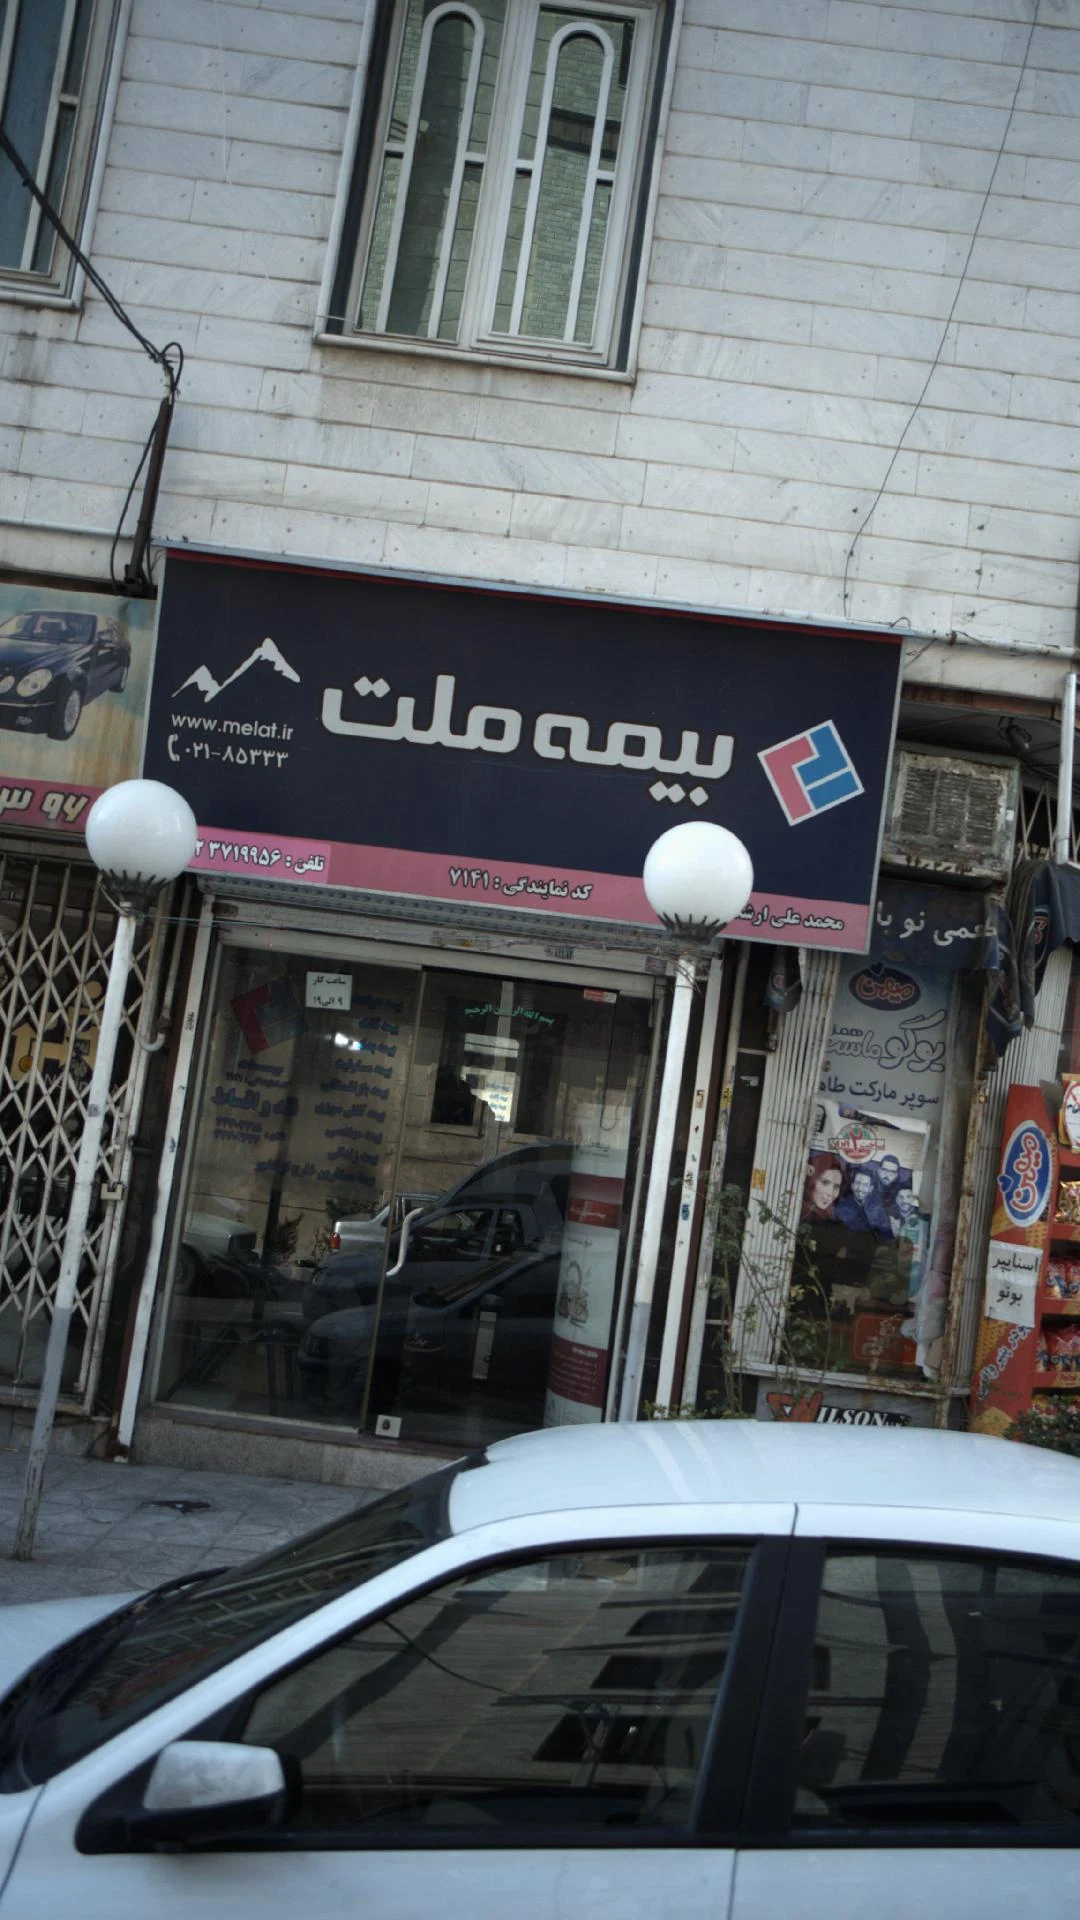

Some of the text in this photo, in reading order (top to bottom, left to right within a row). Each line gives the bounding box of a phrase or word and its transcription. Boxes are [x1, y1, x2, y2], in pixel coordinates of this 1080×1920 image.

[171, 714, 294, 742] www.melat.ir
[321, 674, 735, 806] بیمه ملت
[449, 866, 489, 888] ۷۱۴۱
[572, 882, 592, 900] کد
[738, 904, 844, 931] محمد علی ارش
[900, 909, 925, 939] نو
[854, 972, 914, 1003] میهن
[849, 1080, 897, 1102] مارکت
[899, 1091, 939, 1108] سوپر
[992, 1251, 1039, 1277] اسنایپر
